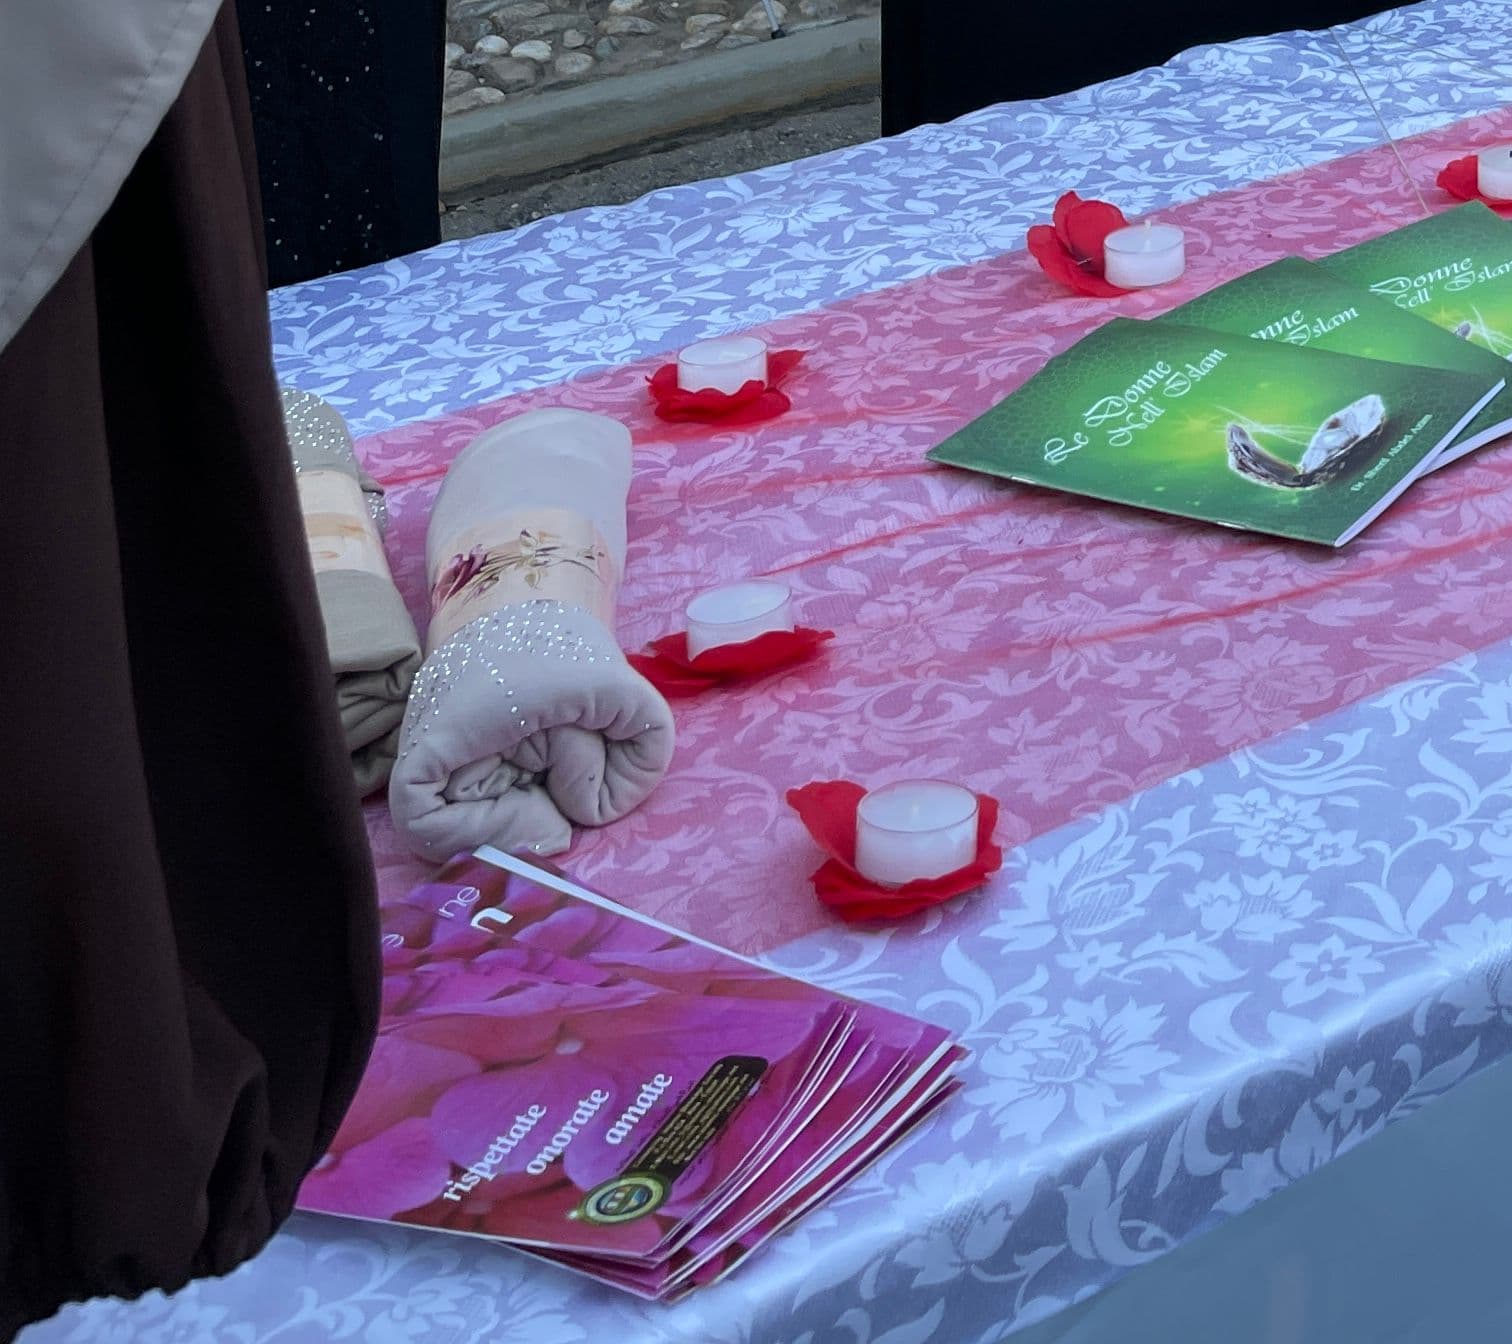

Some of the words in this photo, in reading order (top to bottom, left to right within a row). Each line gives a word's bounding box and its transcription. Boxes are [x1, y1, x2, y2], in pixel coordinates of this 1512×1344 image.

[1369, 257, 1473, 295] Donne
[1082, 360, 1172, 428] Donne
[1162, 347, 1228, 398] Islam
[526, 1087, 610, 1176] onorate
[604, 1072, 673, 1146] amate
[443, 1102, 547, 1202] rispettate
